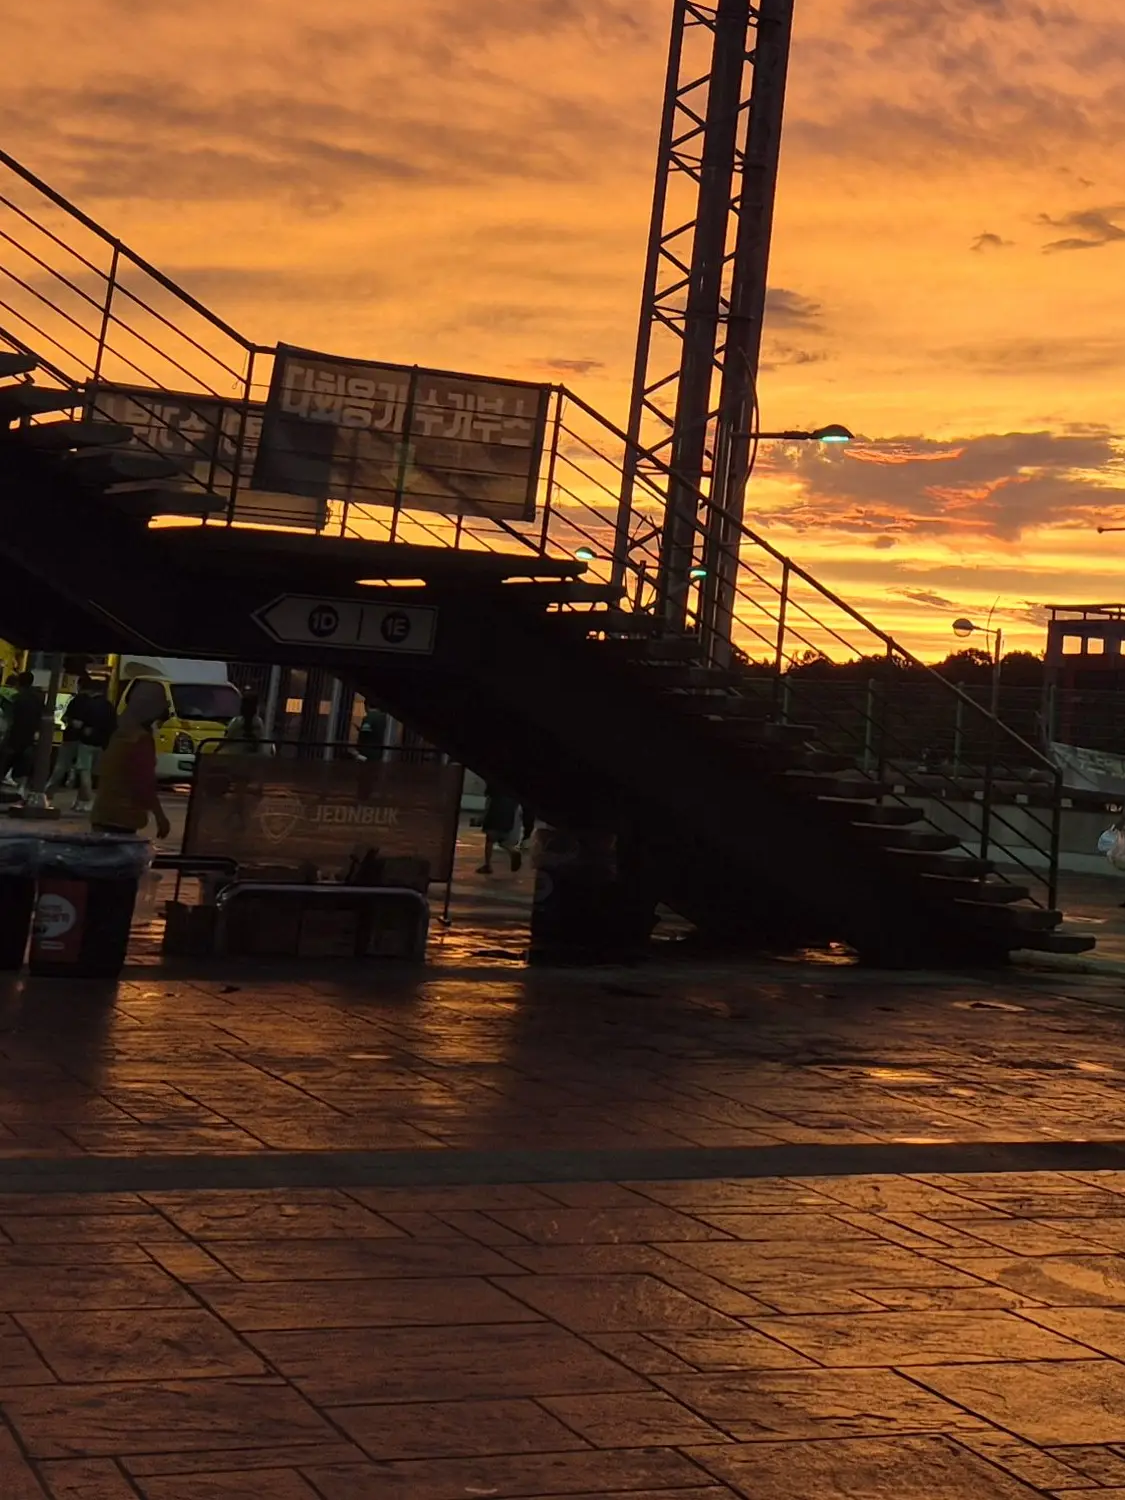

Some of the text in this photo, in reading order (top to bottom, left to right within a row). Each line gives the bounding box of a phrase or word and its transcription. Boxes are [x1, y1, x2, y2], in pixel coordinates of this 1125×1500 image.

[281, 364, 407, 434] 다회용기
[412, 388, 531, 447] 수거부스
[312, 612, 408, 637] 1D 1E
[310, 804, 400, 826] JEONBUK
